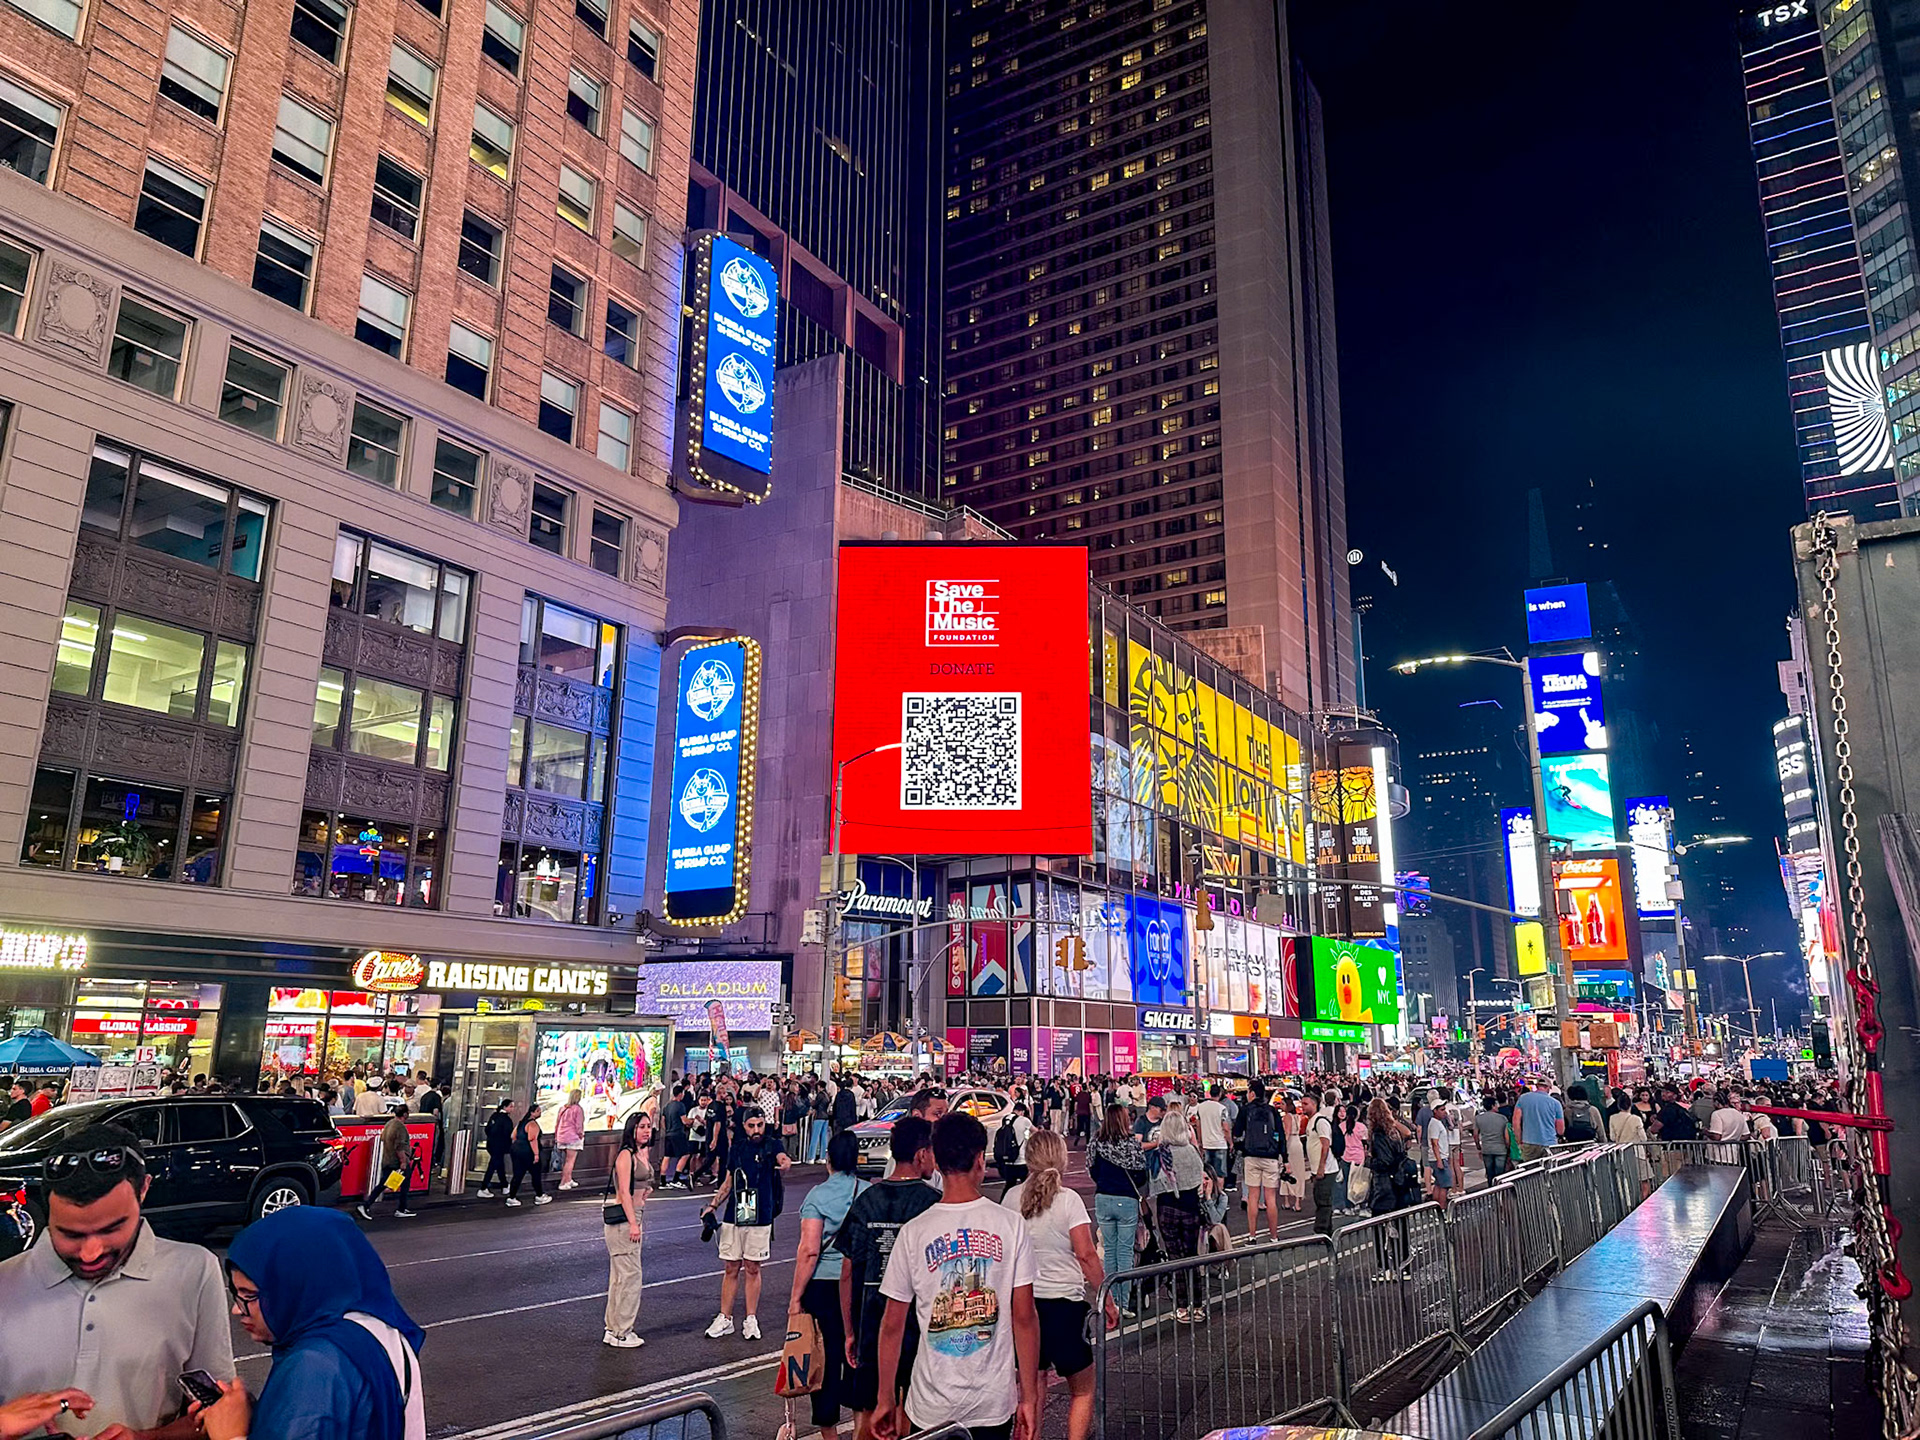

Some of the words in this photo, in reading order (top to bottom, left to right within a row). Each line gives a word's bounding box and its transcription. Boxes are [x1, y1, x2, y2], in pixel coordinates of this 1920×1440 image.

[758, 0, 809, 27] TSX
[713, 311, 744, 335] BUBBA
[745, 328, 772, 348] GUMP
[716, 322, 752, 347] SHRIMP
[752, 341, 768, 357] CO.
[709, 410, 741, 433] BUBBA
[742, 425, 769, 444] GUMP
[712, 422, 747, 447] SHRIMP
[747, 439, 764, 453] CO.
[934, 581, 984, 596] Save
[934, 596, 974, 613] The
[1528, 602, 1537, 612] is
[1539, 600, 1566, 611] when
[934, 613, 995, 630] Music
[930, 663, 995, 675] DONATE
[679, 735, 709, 748] BUBBA
[710, 729, 737, 743] GUMP
[681, 744, 716, 757] SHRIMP
[716, 741, 732, 753] CO.
[1246, 734, 1270, 769] THE
[1353, 827, 1369, 836] THE
[1352, 836, 1372, 845] SHOW
[672, 848, 702, 860] BUBBA
[703, 843, 731, 854] GUMP
[1348, 854, 1379, 863] LIFETIME
[674, 857, 709, 870] SHRIMP
[709, 854, 726, 866] CO.
[1562, 859, 1605, 874] Coca-Cola
[355, 951, 423, 987] Cane's
[427, 961, 529, 992] RAISING
[530, 967, 608, 996] CANE'S
[660, 982, 768, 996] PALLADIUM
[1580, 985, 1589, 996] W
[1594, 985, 1605, 996] 44
[1378, 990, 1391, 1005] NYC
[99, 1021, 139, 1032] GLOBAL
[684, 1017, 740, 1027] ticketmter
[1144, 1011, 1208, 1030] SKECHES
[289, 1025, 317, 1034] FLAGS
[924, 1228, 1003, 1272] ORLANDO
[788, 1353, 811, 1390] N
